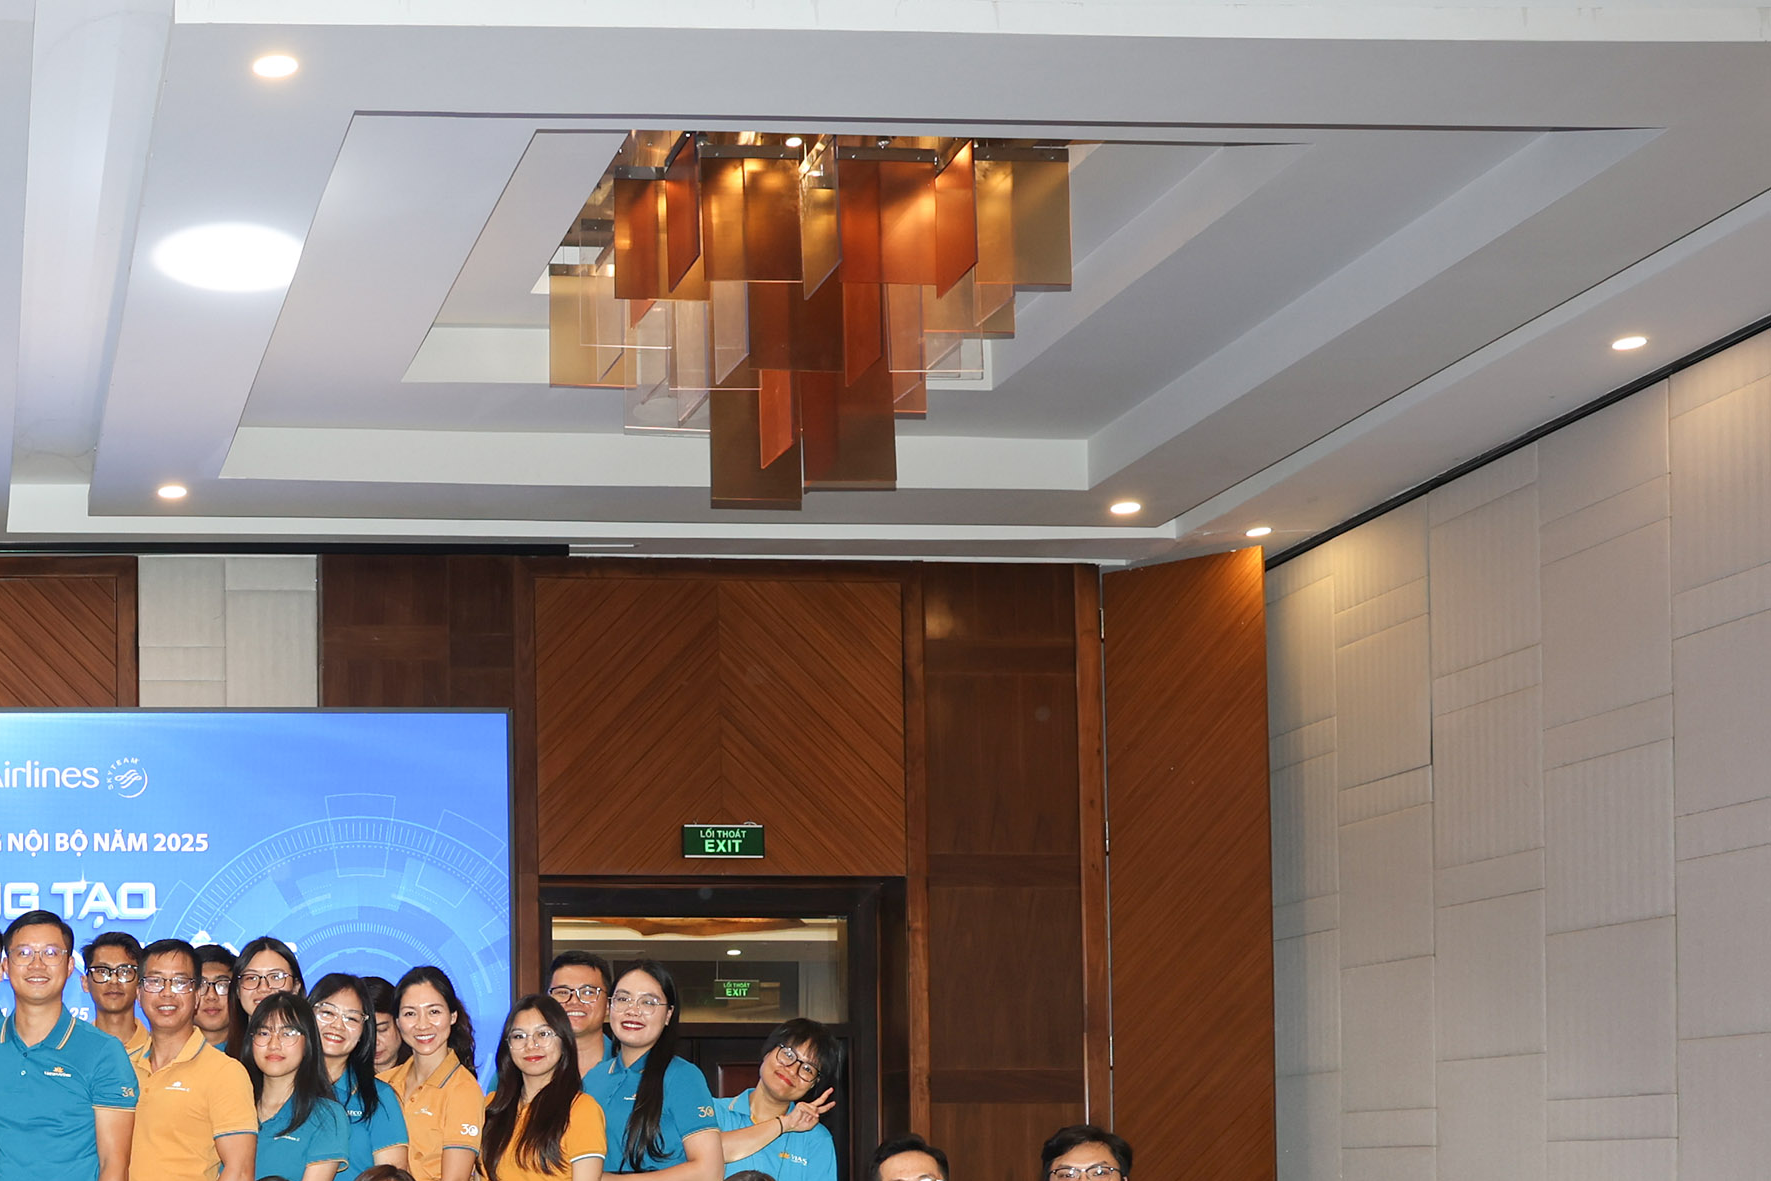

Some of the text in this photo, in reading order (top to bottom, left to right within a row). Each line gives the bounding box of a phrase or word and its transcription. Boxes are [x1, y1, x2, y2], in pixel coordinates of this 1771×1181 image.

[106, 757, 140, 790] SKYTEAM
[7, 829, 49, 857] NỘI
[55, 829, 88, 857] BỘ
[93, 829, 148, 852] NĂM
[153, 833, 209, 852] 2025
[700, 828, 746, 838] LỐI THOÁT
[705, 840, 742, 852] EXIT
[51, 882, 156, 929] TẠO
